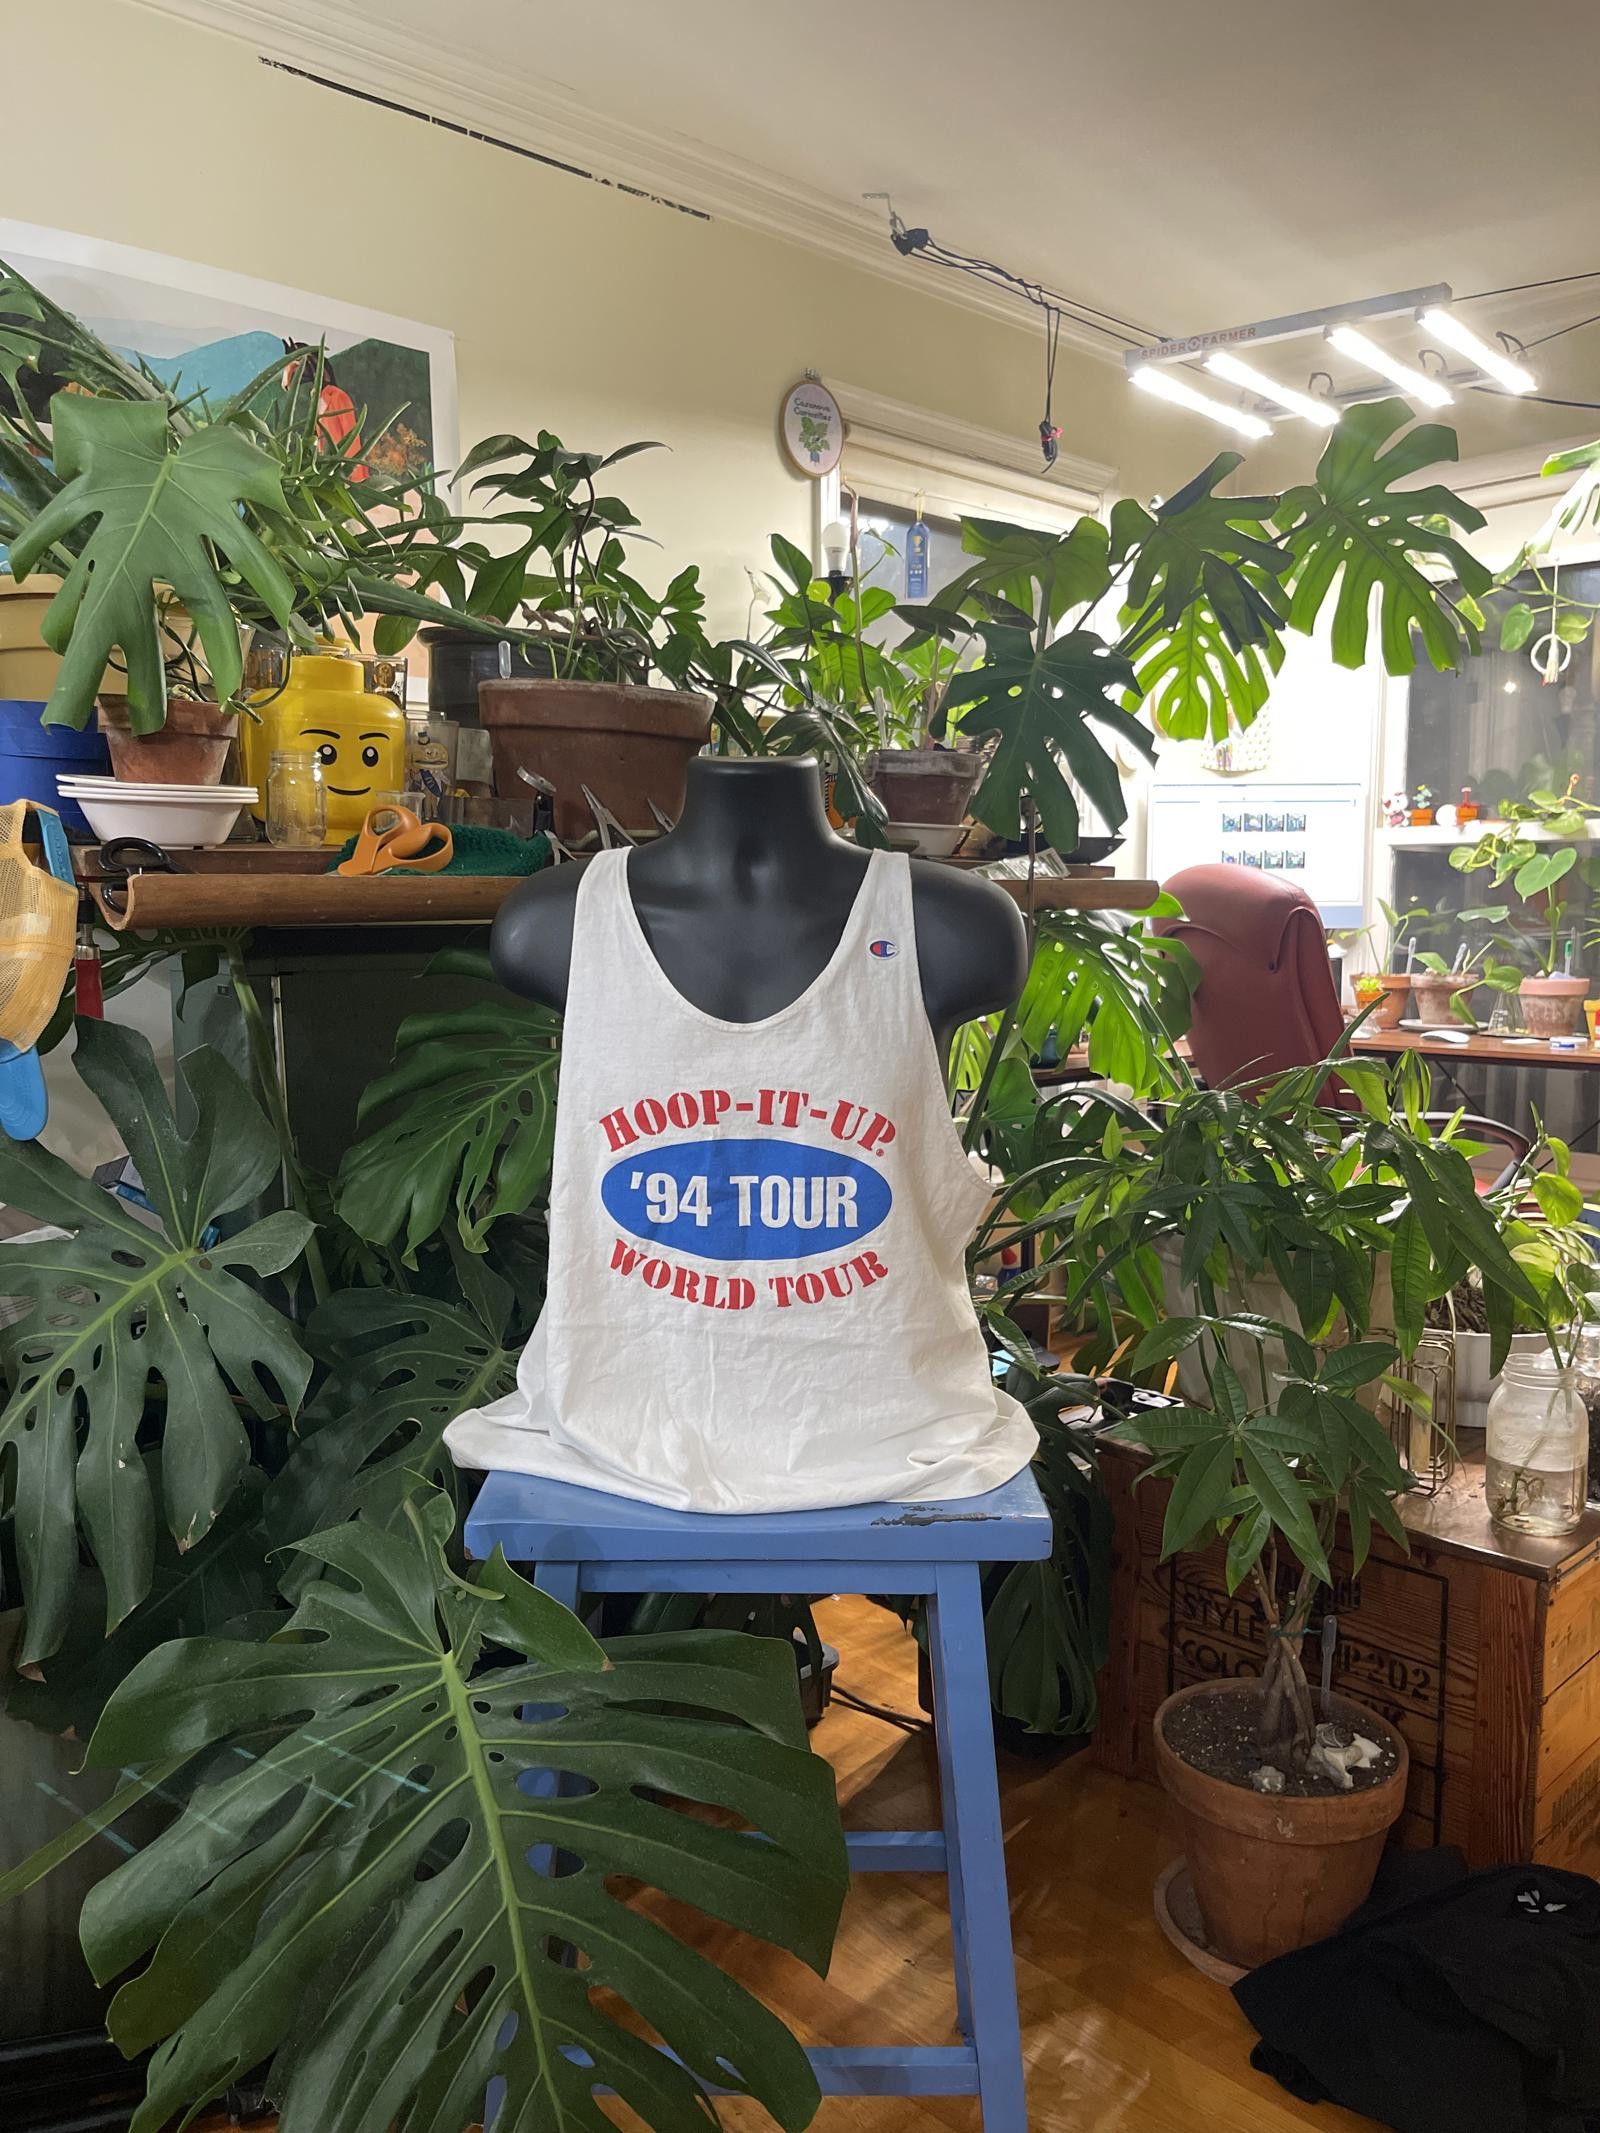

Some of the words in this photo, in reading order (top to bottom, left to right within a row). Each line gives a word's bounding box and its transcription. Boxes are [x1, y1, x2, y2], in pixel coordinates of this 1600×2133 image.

[1140, 342, 1186, 361] SPIDER
[1201, 326, 1257, 347] FARMER
[630, 1171, 712, 1227] '94
[729, 1175, 859, 1229] TOUR
[609, 1237, 756, 1310] WORLD
[768, 1250, 889, 1307] TOUR
[1181, 1639, 1265, 1679] COLO
